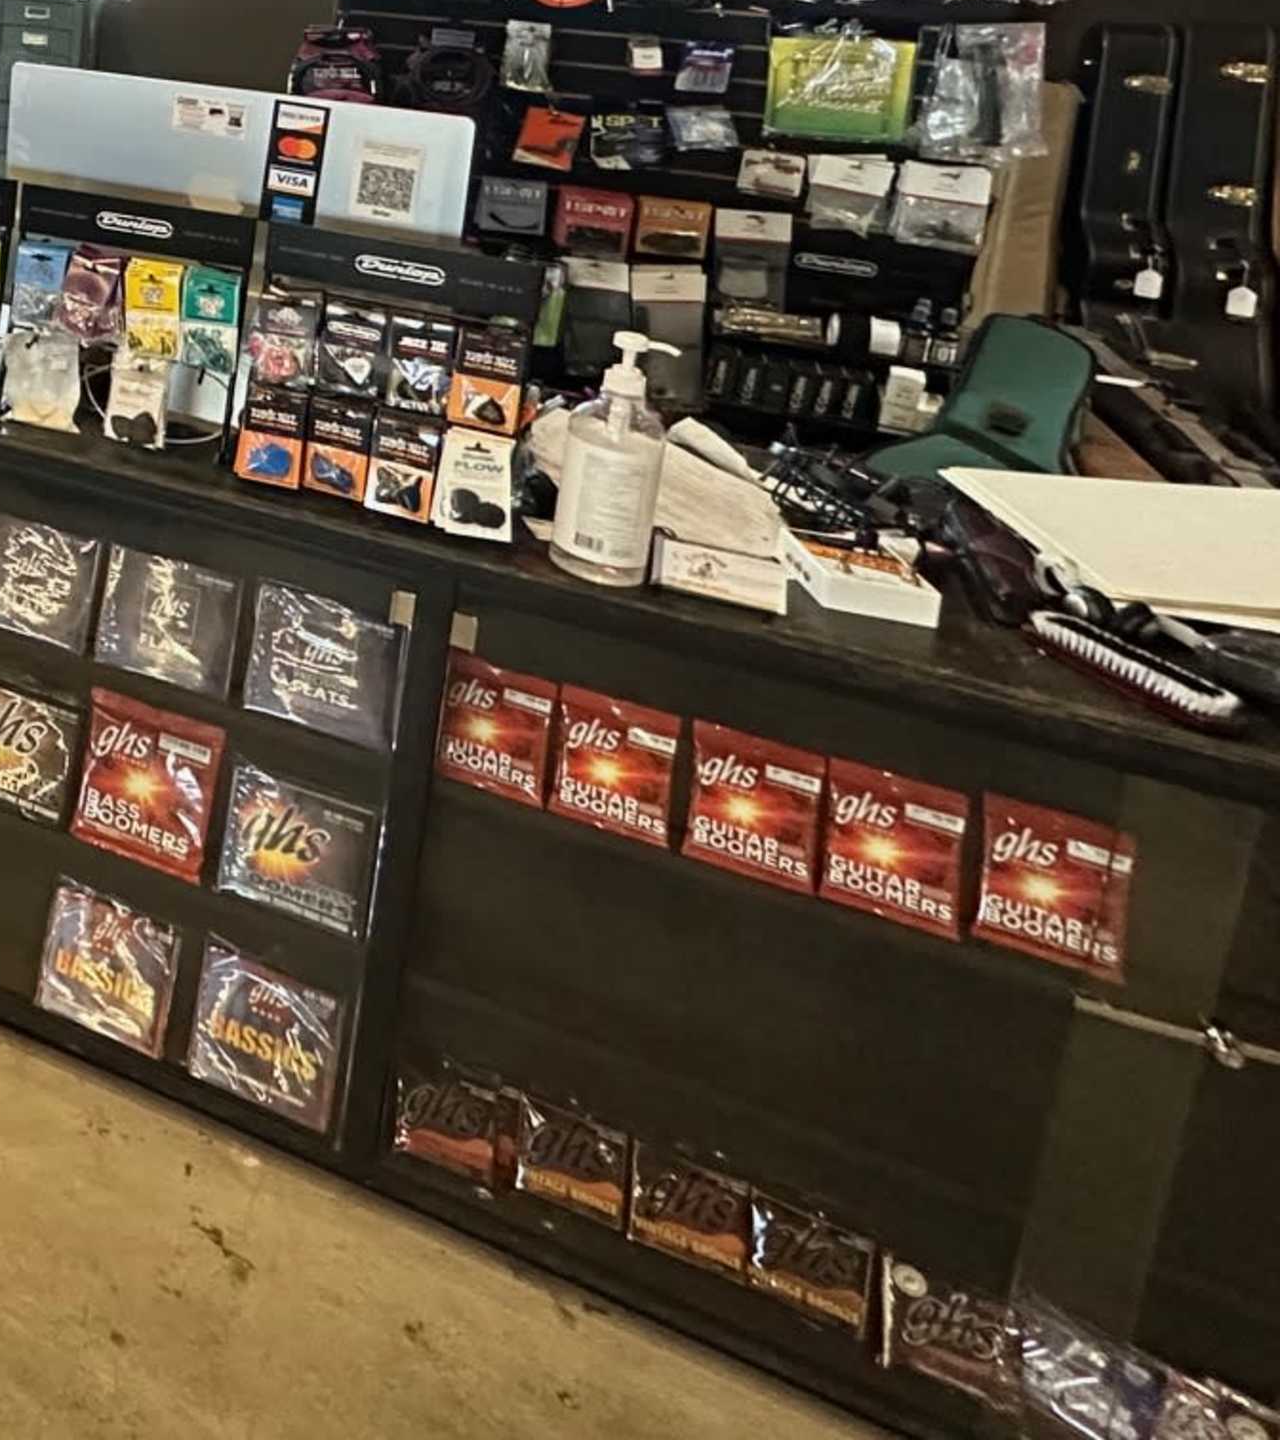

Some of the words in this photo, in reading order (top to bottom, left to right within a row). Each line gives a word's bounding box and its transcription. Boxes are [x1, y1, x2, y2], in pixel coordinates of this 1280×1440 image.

[276, 172, 310, 189] VISA
[100, 213, 171, 237] Dunlop
[362, 257, 441, 283] Dunlop
[454, 460, 505, 475] FLOW
[449, 678, 499, 712] ghs
[95, 721, 152, 759] ghs
[567, 717, 622, 751] ghs
[698, 754, 758, 789] ghs
[86, 787, 141, 820] BASS
[559, 790, 667, 835] BOOMERS
[560, 777, 639, 813] GUITAR
[834, 790, 898, 829] ghs
[84, 803, 189, 856] BOOMERS
[241, 806, 333, 865] ghs
[693, 815, 779, 855] GUITAR
[992, 826, 1060, 869] ghs
[692, 829, 810, 879] BOOMERS
[829, 853, 922, 897] GUITAR
[828, 868, 953, 922] BOOMERS
[983, 907, 1119, 963] BOOMERS
[985, 893, 1085, 938] GUITAR
